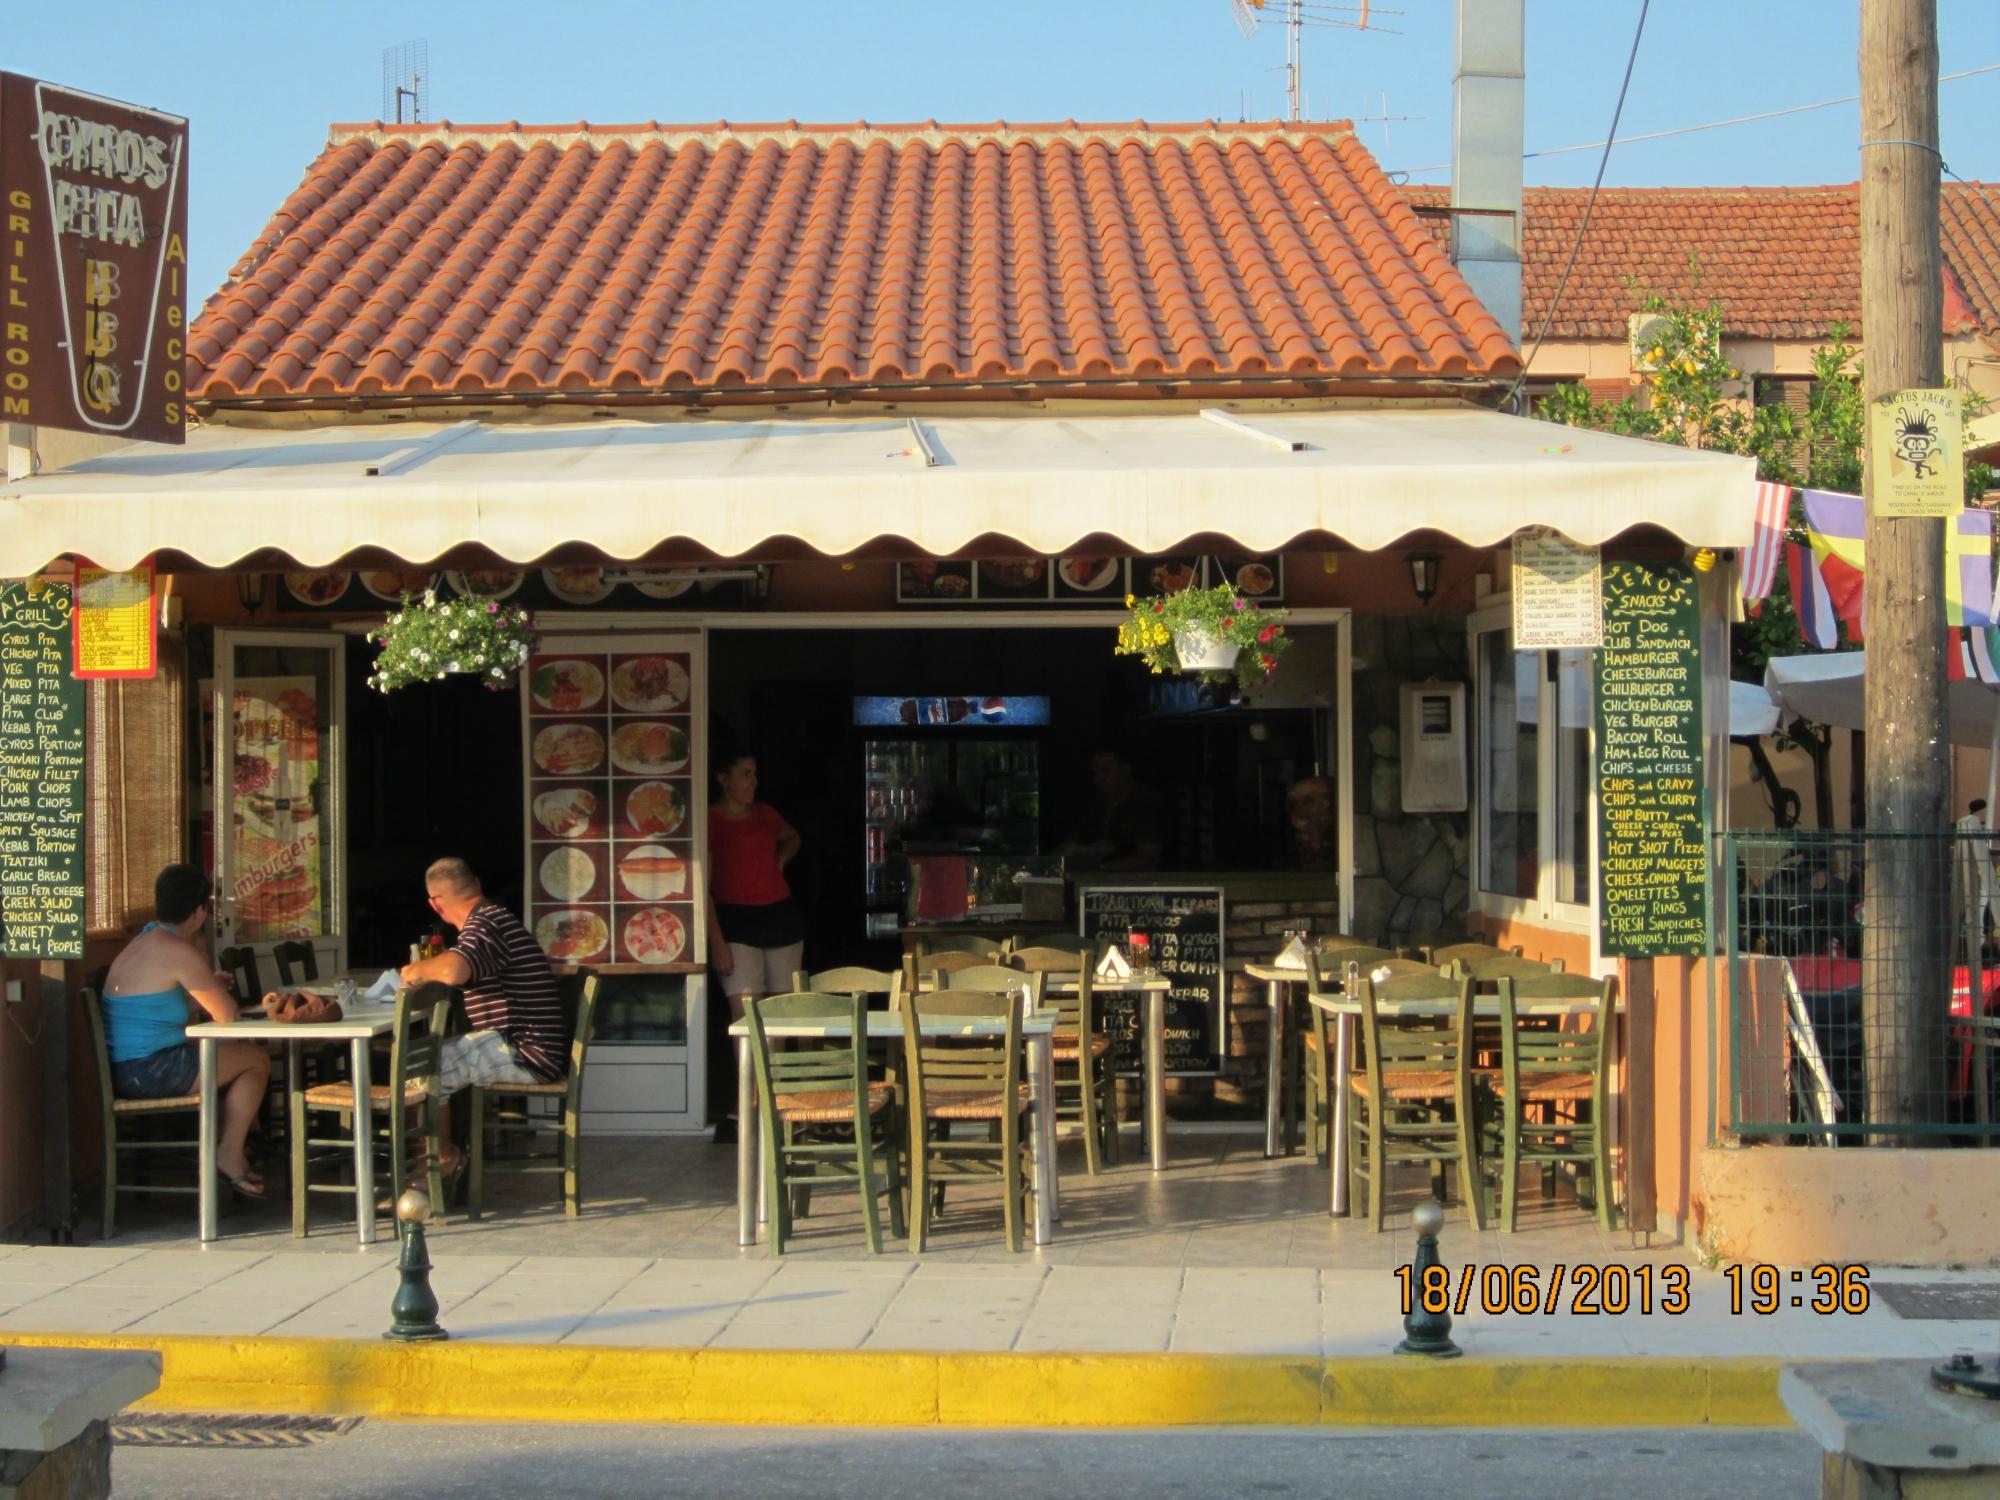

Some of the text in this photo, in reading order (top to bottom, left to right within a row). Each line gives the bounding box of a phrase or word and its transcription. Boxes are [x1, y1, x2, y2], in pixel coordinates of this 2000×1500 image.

[4, 191, 31, 416] GRILL ROOM
[1880, 391, 1918, 409] CACTUS
[1601, 570, 1687, 611] ALEKOS
[1619, 595, 1667, 609] SNACKS
[16, 609, 50, 621] GRILL
[1603, 619, 1669, 634] HOT DOG
[2, 632, 56, 646] GYROS PITA
[1602, 634, 1691, 650] CLUB SANDWICH
[1, 647, 62, 660] CHICKEN PITA
[1604, 650, 1680, 666] HAMBURGER
[3, 662, 59, 675] VEG PITA
[1601, 667, 1688, 681] CHEESEBURGER
[3, 677, 60, 690] MIXED PITA
[3, 691, 60, 705] LARGE PITA
[3, 704, 63, 720] PITA CLUB
[2, 721, 58, 734] KEBAB PITA
[1603, 713, 1679, 729] VEG. BURGER
[0, 735, 82, 750] GYROS PORTION
[1606, 728, 1688, 744] BACON ROLL
[0, 751, 83, 765] SOUVLAKI PORTION
[1661, 744, 1691, 760] ROLL
[0, 766, 79, 780] CHICKEN FILLET
[1600, 761, 1694, 775] CHIPS with CHEESE
[1, 778, 71, 793] PORK CHOPS
[1601, 777, 1695, 791] CHIPS with GRAVY
[1, 795, 72, 808] LAMB CHOPS
[1602, 793, 1697, 806] CHIPS with CURRY
[0, 812, 35, 822] CHICKEN
[59, 810, 83, 823] SPIT
[1606, 808, 1696, 822] CHIP BUTTY with
[29, 823, 77, 838] SAUSAGE
[1612, 822, 1644, 830] CHEESE
[1616, 830, 1645, 838] GRAVY
[1662, 830, 1683, 838] PEAS
[36, 837, 76, 852] PORTION
[1608, 838, 1706, 856] HOT SHOT PIZZA
[1, 855, 48, 866] TZATZIKI
[1606, 856, 1706, 871] CHICKEN NUGGETS
[1, 869, 70, 881] GARLIC BREAD
[1605, 872, 1645, 887] CHEESE
[1649, 872, 1680, 885] ONION
[32, 884, 50, 896] FETA
[53, 886, 85, 897] CHEESE
[1606, 885, 1680, 902] OMELETTES
[2, 896, 73, 909] GREEK SALAD
[1087, 892, 1169, 911] TRADITIONAL
[1608, 900, 1687, 917] ONION RINGS
[2, 910, 79, 923] CHICKEN SALAD
[1098, 913, 1182, 929] PITA GYROS
[1611, 915, 1704, 933] FRESH SANDICHES
[6, 925, 55, 938] VARIETY
[1618, 929, 1706, 946] (VARIOUS FILLINGS)
[1152, 932, 1179, 946] PITA
[1182, 932, 1220, 945] GYROS
[47, 939, 82, 954] PEOPLE
[1162, 945, 1180, 958] ON
[1183, 946, 1216, 961] PITA
[1179, 960, 1197, 973] ON
[1168, 987, 1210, 1003] KEBAB
